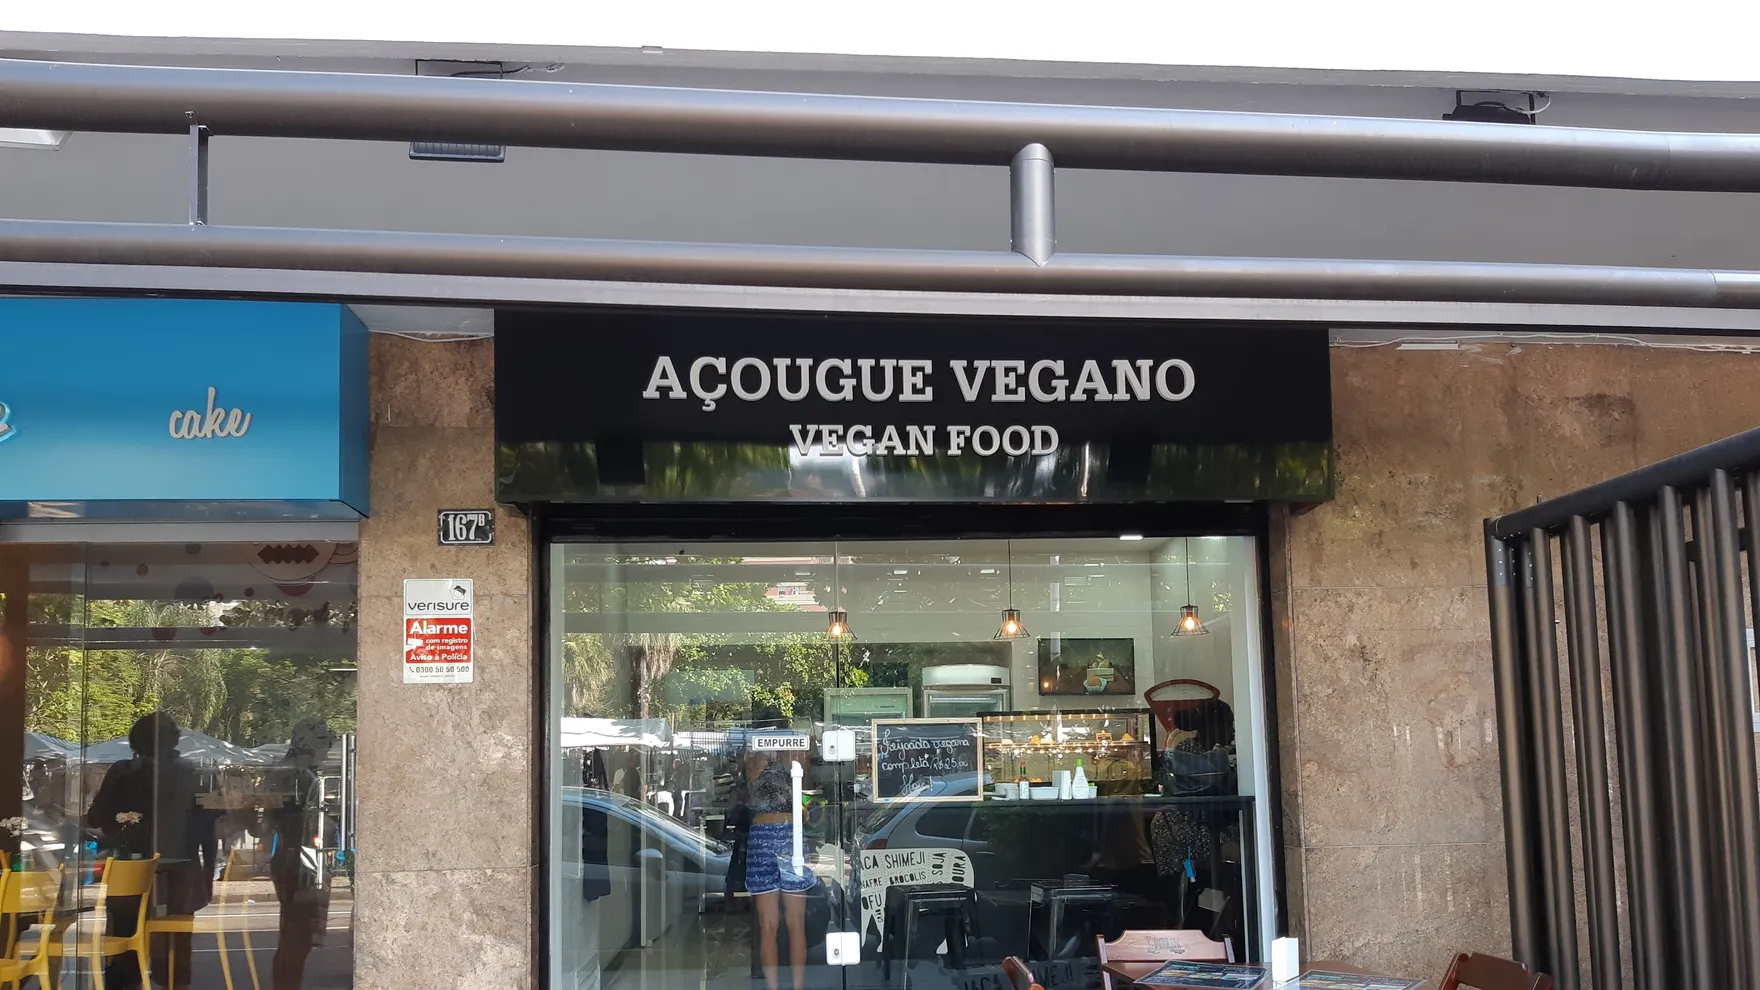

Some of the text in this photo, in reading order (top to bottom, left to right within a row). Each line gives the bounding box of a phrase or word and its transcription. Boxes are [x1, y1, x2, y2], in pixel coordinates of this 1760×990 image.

[643, 356, 1196, 411] AÇOUGUE VEGANO
[169, 386, 252, 440] cake
[789, 424, 1059, 457] VEGAN FOOD
[408, 601, 470, 611] verisure
[409, 620, 468, 635] Alarme
[437, 644, 468, 652] imagens
[441, 637, 469, 646] registro
[409, 653, 433, 661] Aviso
[757, 738, 806, 748] EMPURRE
[884, 851, 926, 869] SHIMEJI
[932, 852, 947, 876] SOJA
[952, 856, 966, 883] OURA
[861, 894, 882, 911] OFU
